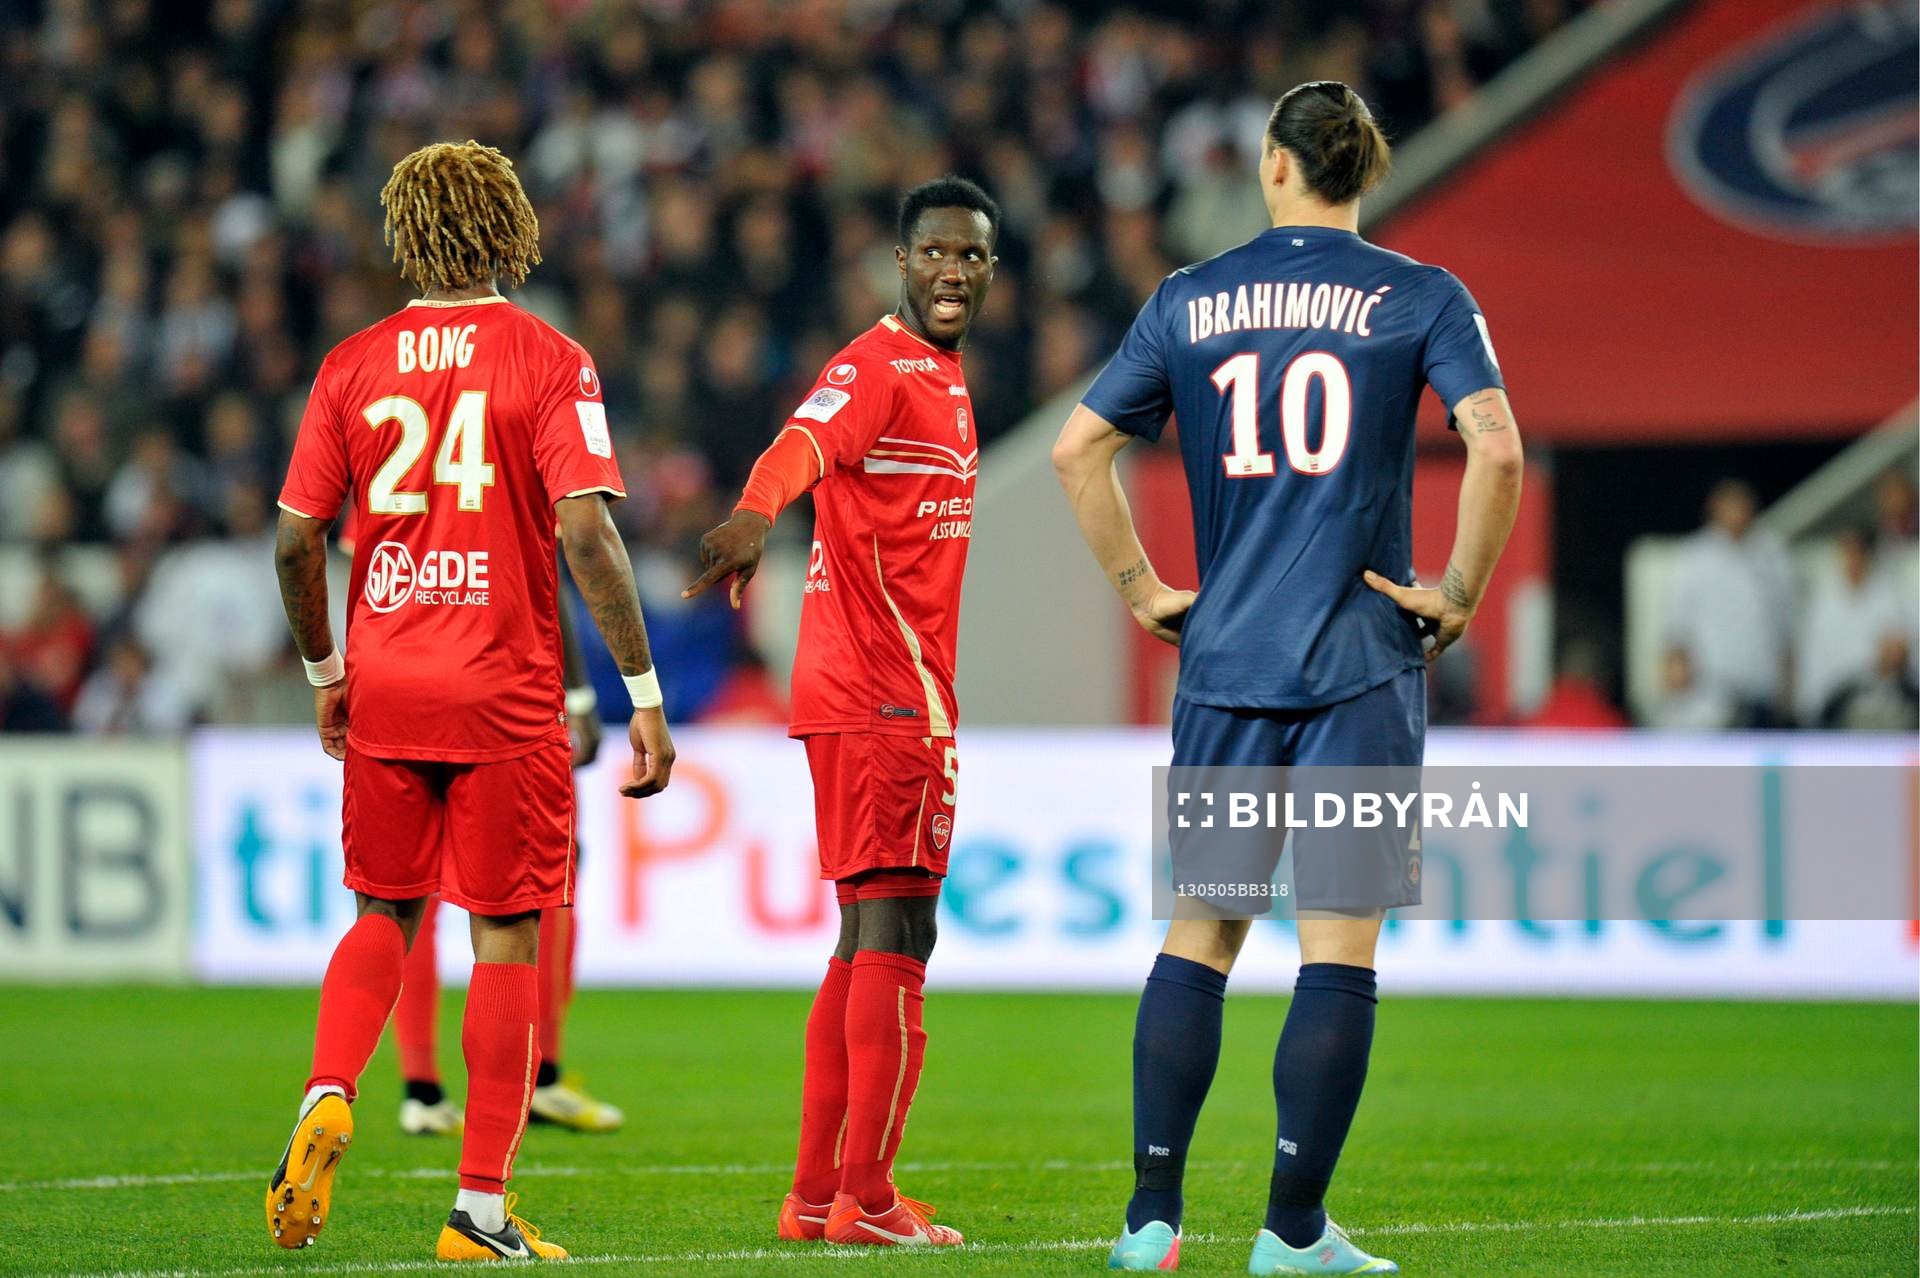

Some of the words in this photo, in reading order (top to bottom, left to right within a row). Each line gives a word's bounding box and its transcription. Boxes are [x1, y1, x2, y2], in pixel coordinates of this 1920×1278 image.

[1187, 284, 1392, 344] IBRAHIMOVIĆ
[398, 323, 478, 374] BONG
[889, 357, 940, 375] TOYOTA
[1210, 350, 1351, 478] 10
[361, 390, 495, 515] 24
[417, 551, 489, 589] GDE
[415, 590, 489, 606] RECYCLAGE
[942, 746, 958, 806] 5
[1148, 1144, 1170, 1156] PSG
[1277, 1137, 1298, 1156] PSG
